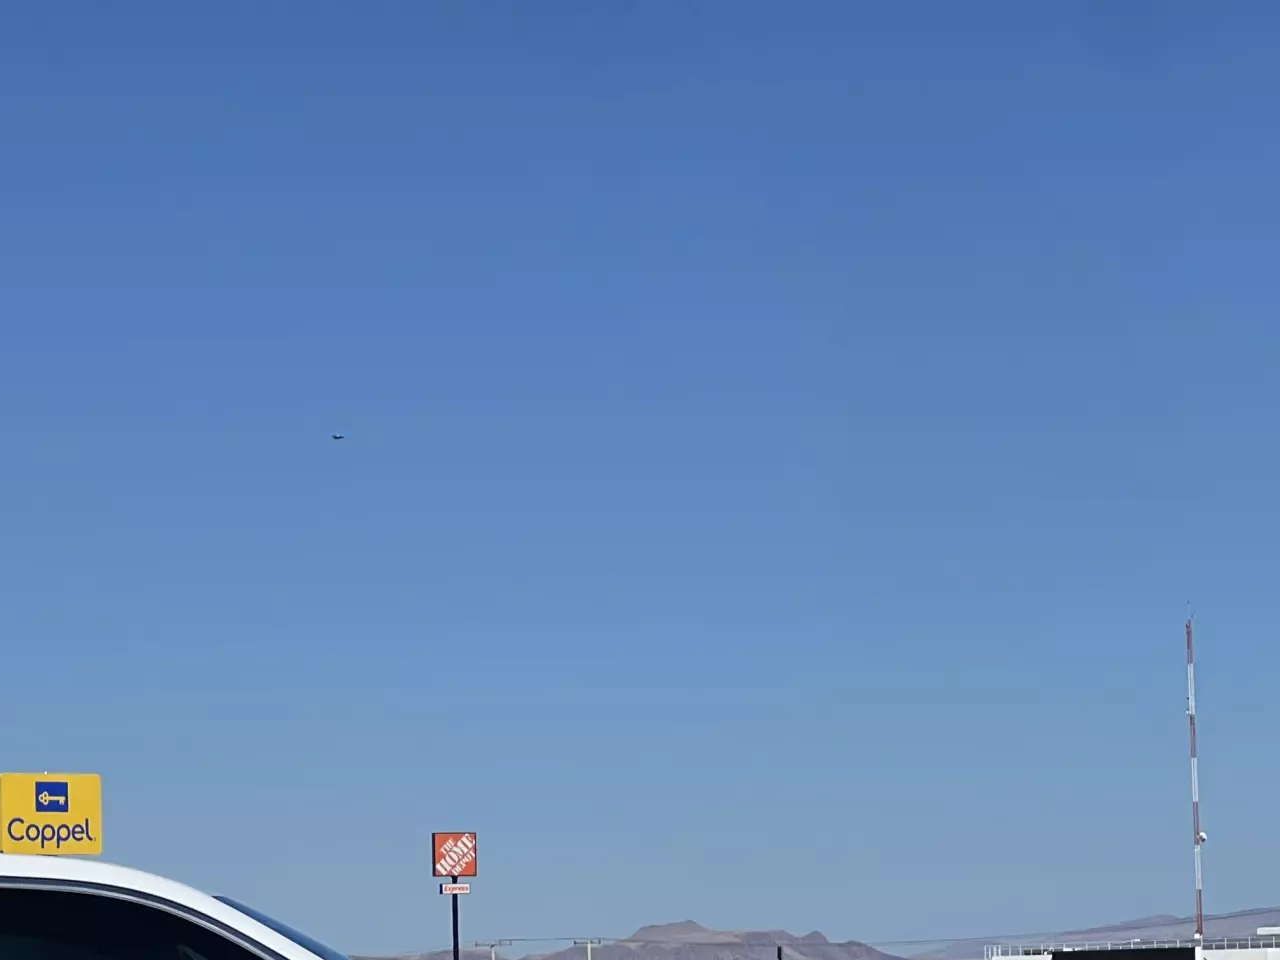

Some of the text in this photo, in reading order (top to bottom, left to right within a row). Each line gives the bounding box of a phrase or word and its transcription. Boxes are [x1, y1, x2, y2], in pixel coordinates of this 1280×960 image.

[7, 817, 93, 849] Coppel
[440, 837, 455, 855] THE
[435, 833, 476, 876] HOME
[451, 850, 476, 876] DEPOT
